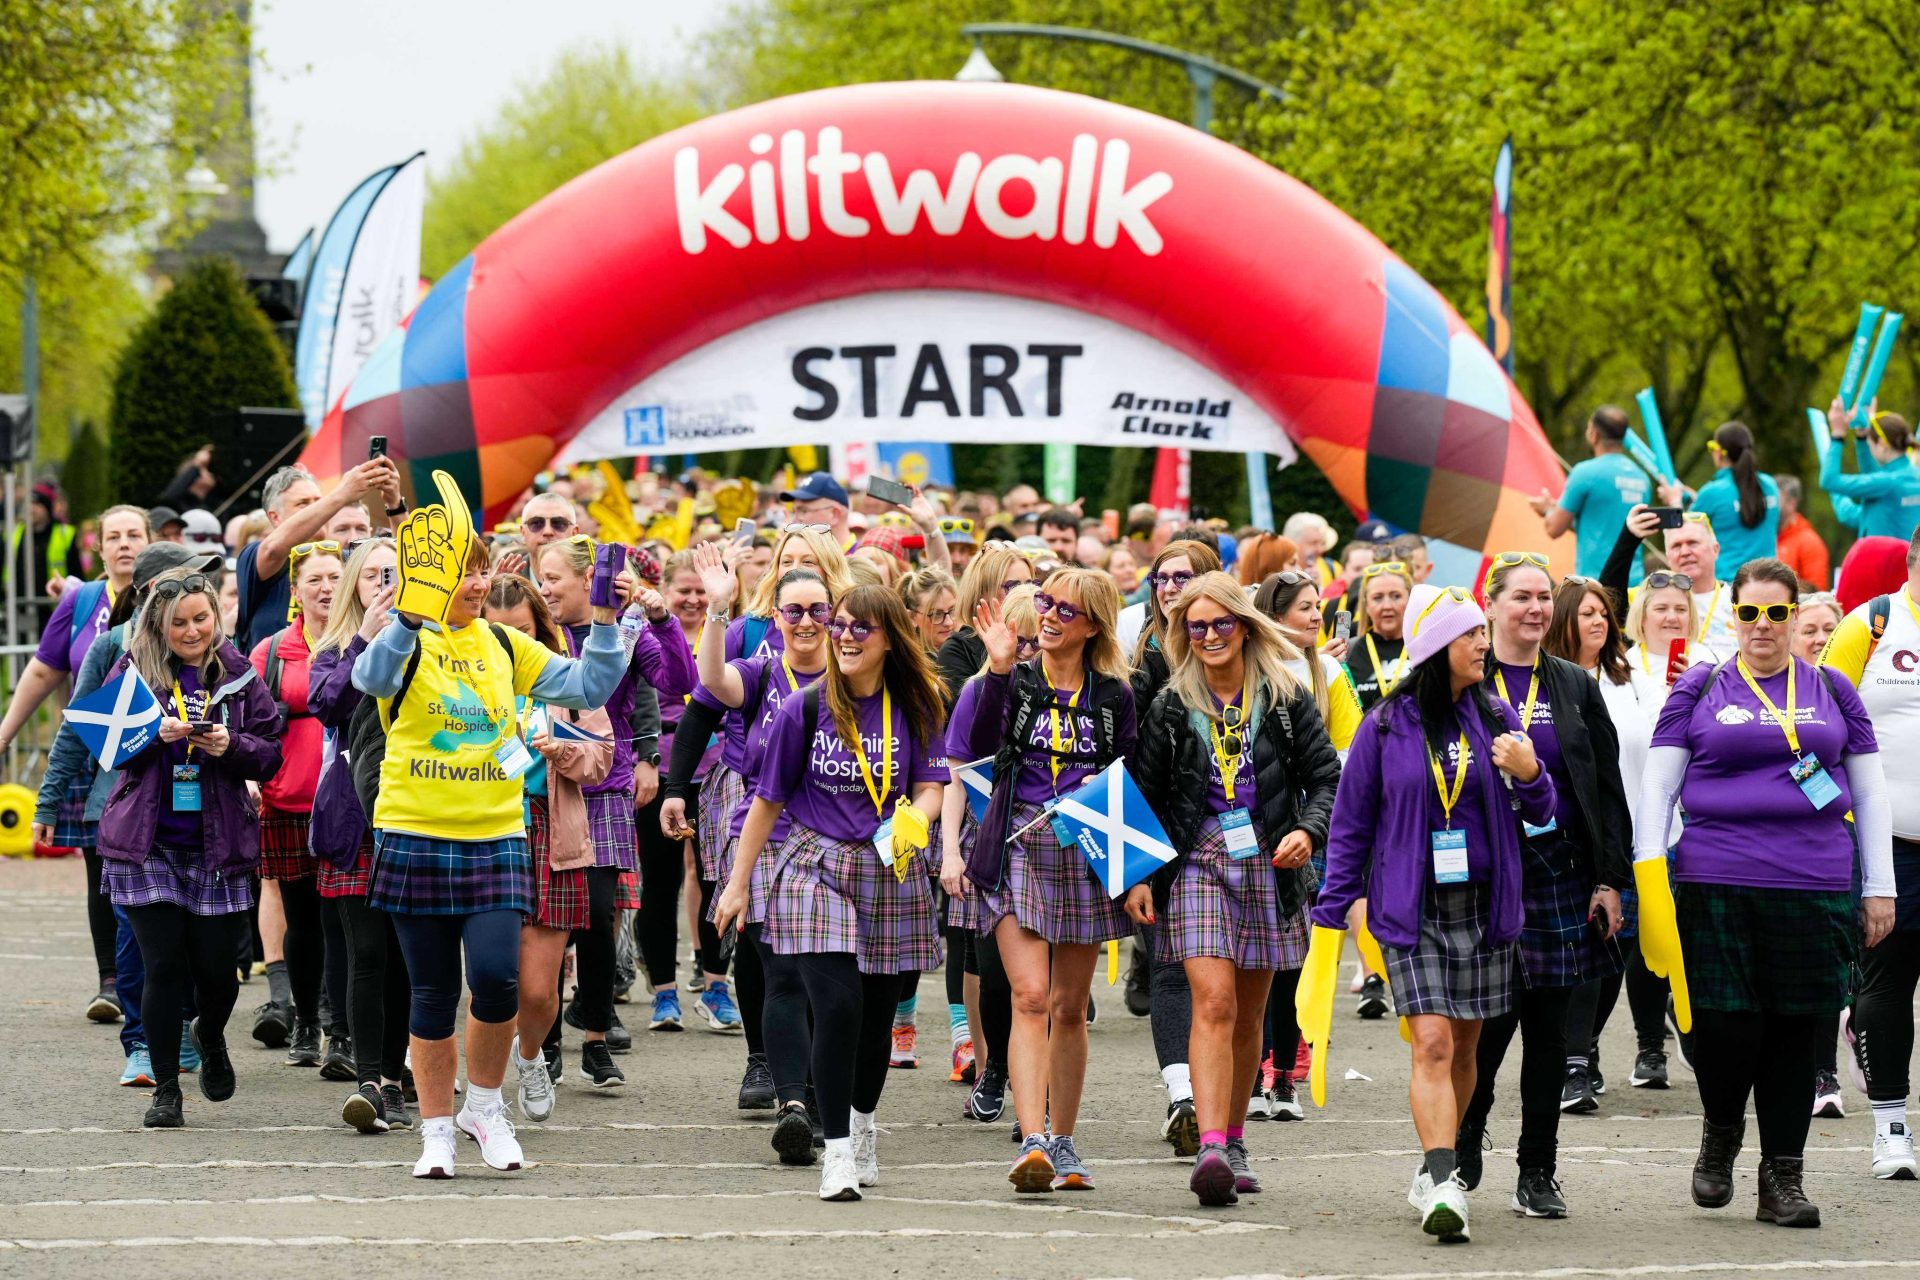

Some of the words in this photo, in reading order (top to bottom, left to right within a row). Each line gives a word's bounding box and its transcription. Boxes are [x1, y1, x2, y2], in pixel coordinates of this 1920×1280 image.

[673, 125, 1174, 256] kiltwalk
[792, 343, 1083, 422] START
[1111, 391, 1232, 419] Arnold
[1121, 415, 1215, 440] Clark
[408, 576, 437, 589] Arnold
[438, 654, 469, 673] I'm
[476, 657, 487, 672] a
[1356, 683, 1378, 691] new
[1876, 677, 1915, 686] Children's
[427, 702, 445, 715] St.
[121, 726, 148, 750] Arnold
[444, 719, 495, 737] Hospice
[127, 734, 150, 754] Clark
[812, 729, 900, 757] Ayrhire
[409, 758, 509, 782] Kiltwalke
[840, 784, 866, 794] today
[1076, 833, 1098, 861] Clark
[1080, 827, 1107, 860] Arnold
